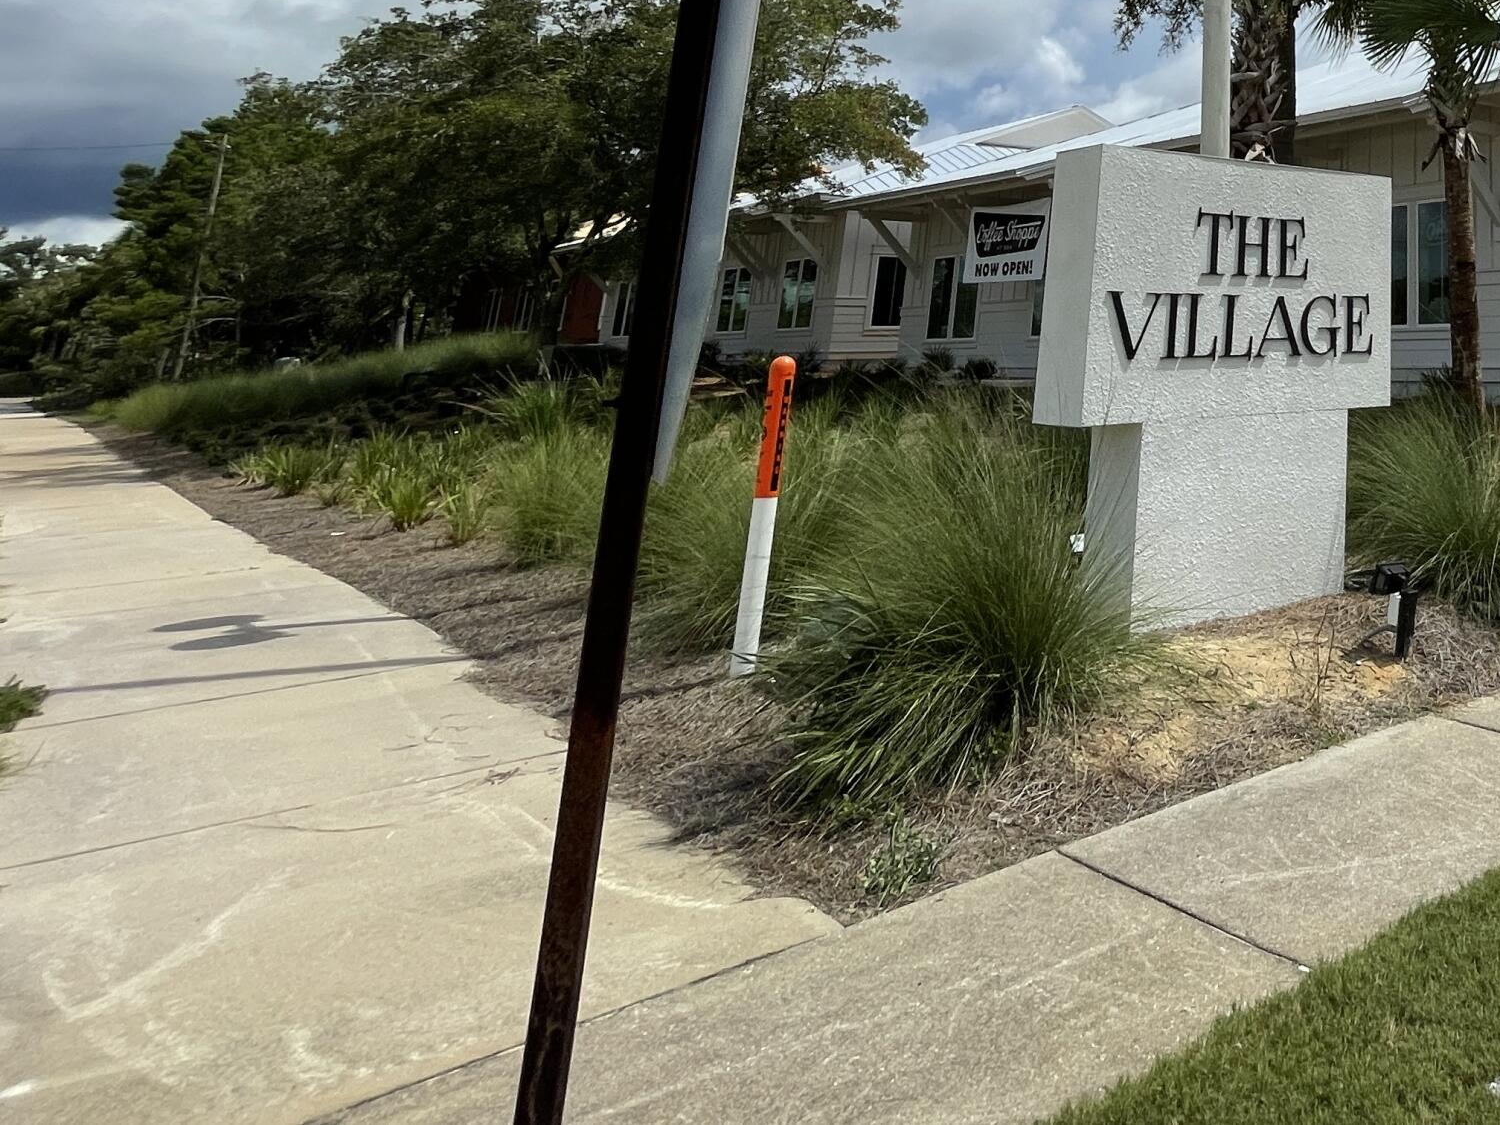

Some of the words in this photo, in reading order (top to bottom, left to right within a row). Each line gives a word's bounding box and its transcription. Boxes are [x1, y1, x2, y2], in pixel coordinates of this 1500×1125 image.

[976, 220, 1005, 251] Coffee
[1005, 219, 1041, 248] Shoppe
[1197, 207, 1309, 281] THE
[975, 263, 999, 277] NOW
[1002, 260, 1033, 275] OPEN!
[1106, 290, 1374, 362] VILLAGE
